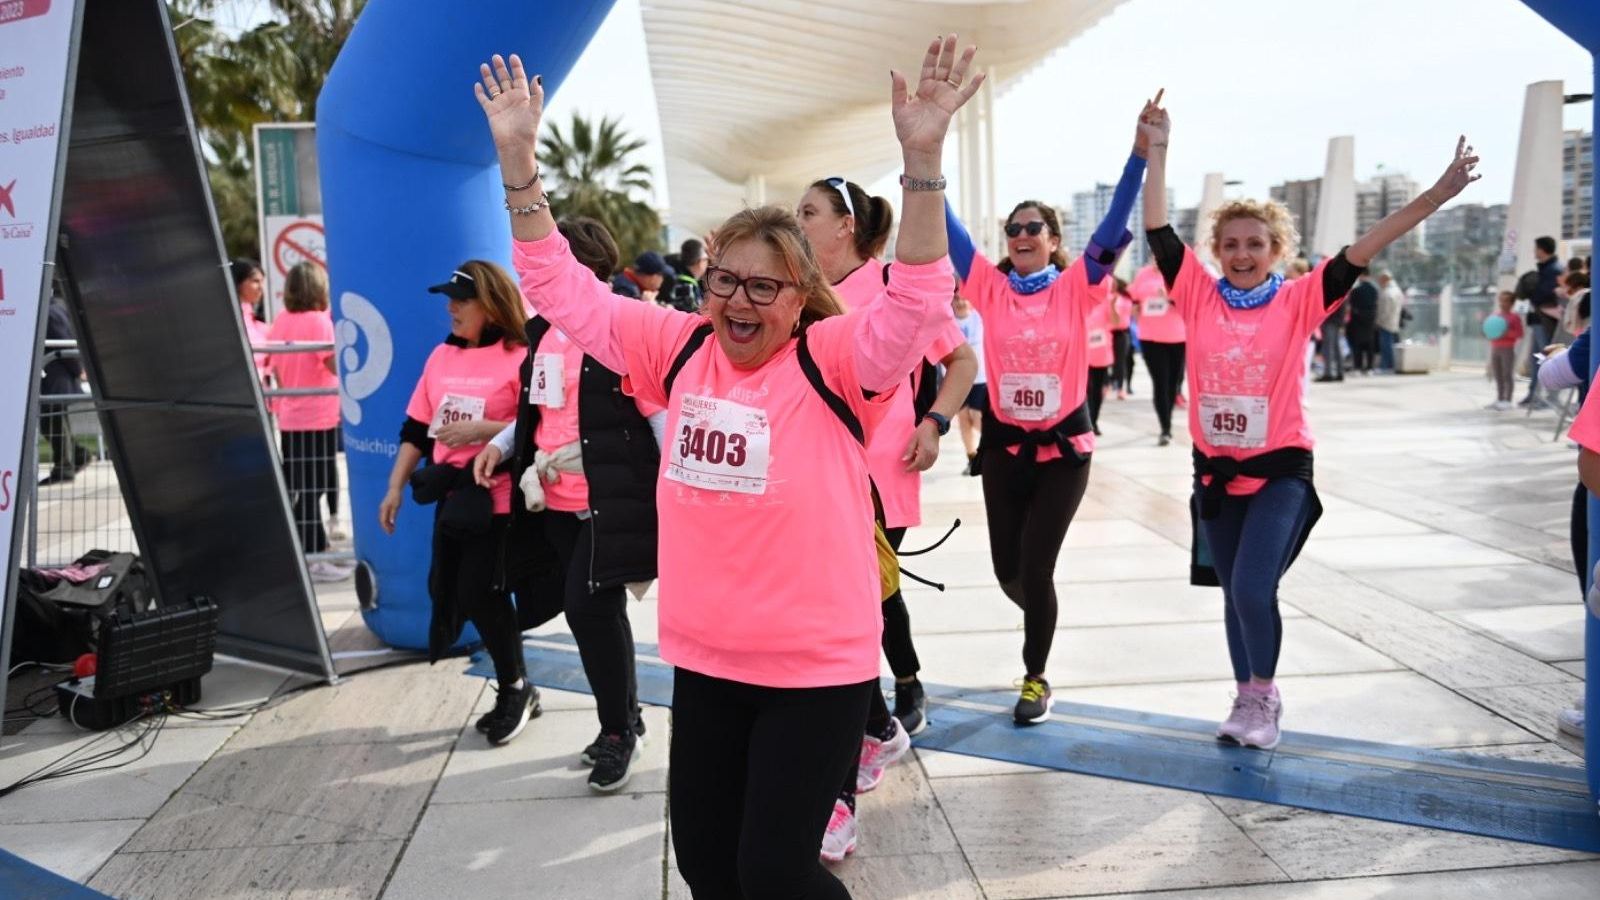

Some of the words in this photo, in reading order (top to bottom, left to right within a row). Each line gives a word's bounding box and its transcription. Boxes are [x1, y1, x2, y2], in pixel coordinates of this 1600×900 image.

[12, 123, 56, 144] Igualdad
[1013, 389, 1045, 408] 460
[1212, 412, 1248, 434] 459
[680, 424, 748, 467] 3403
